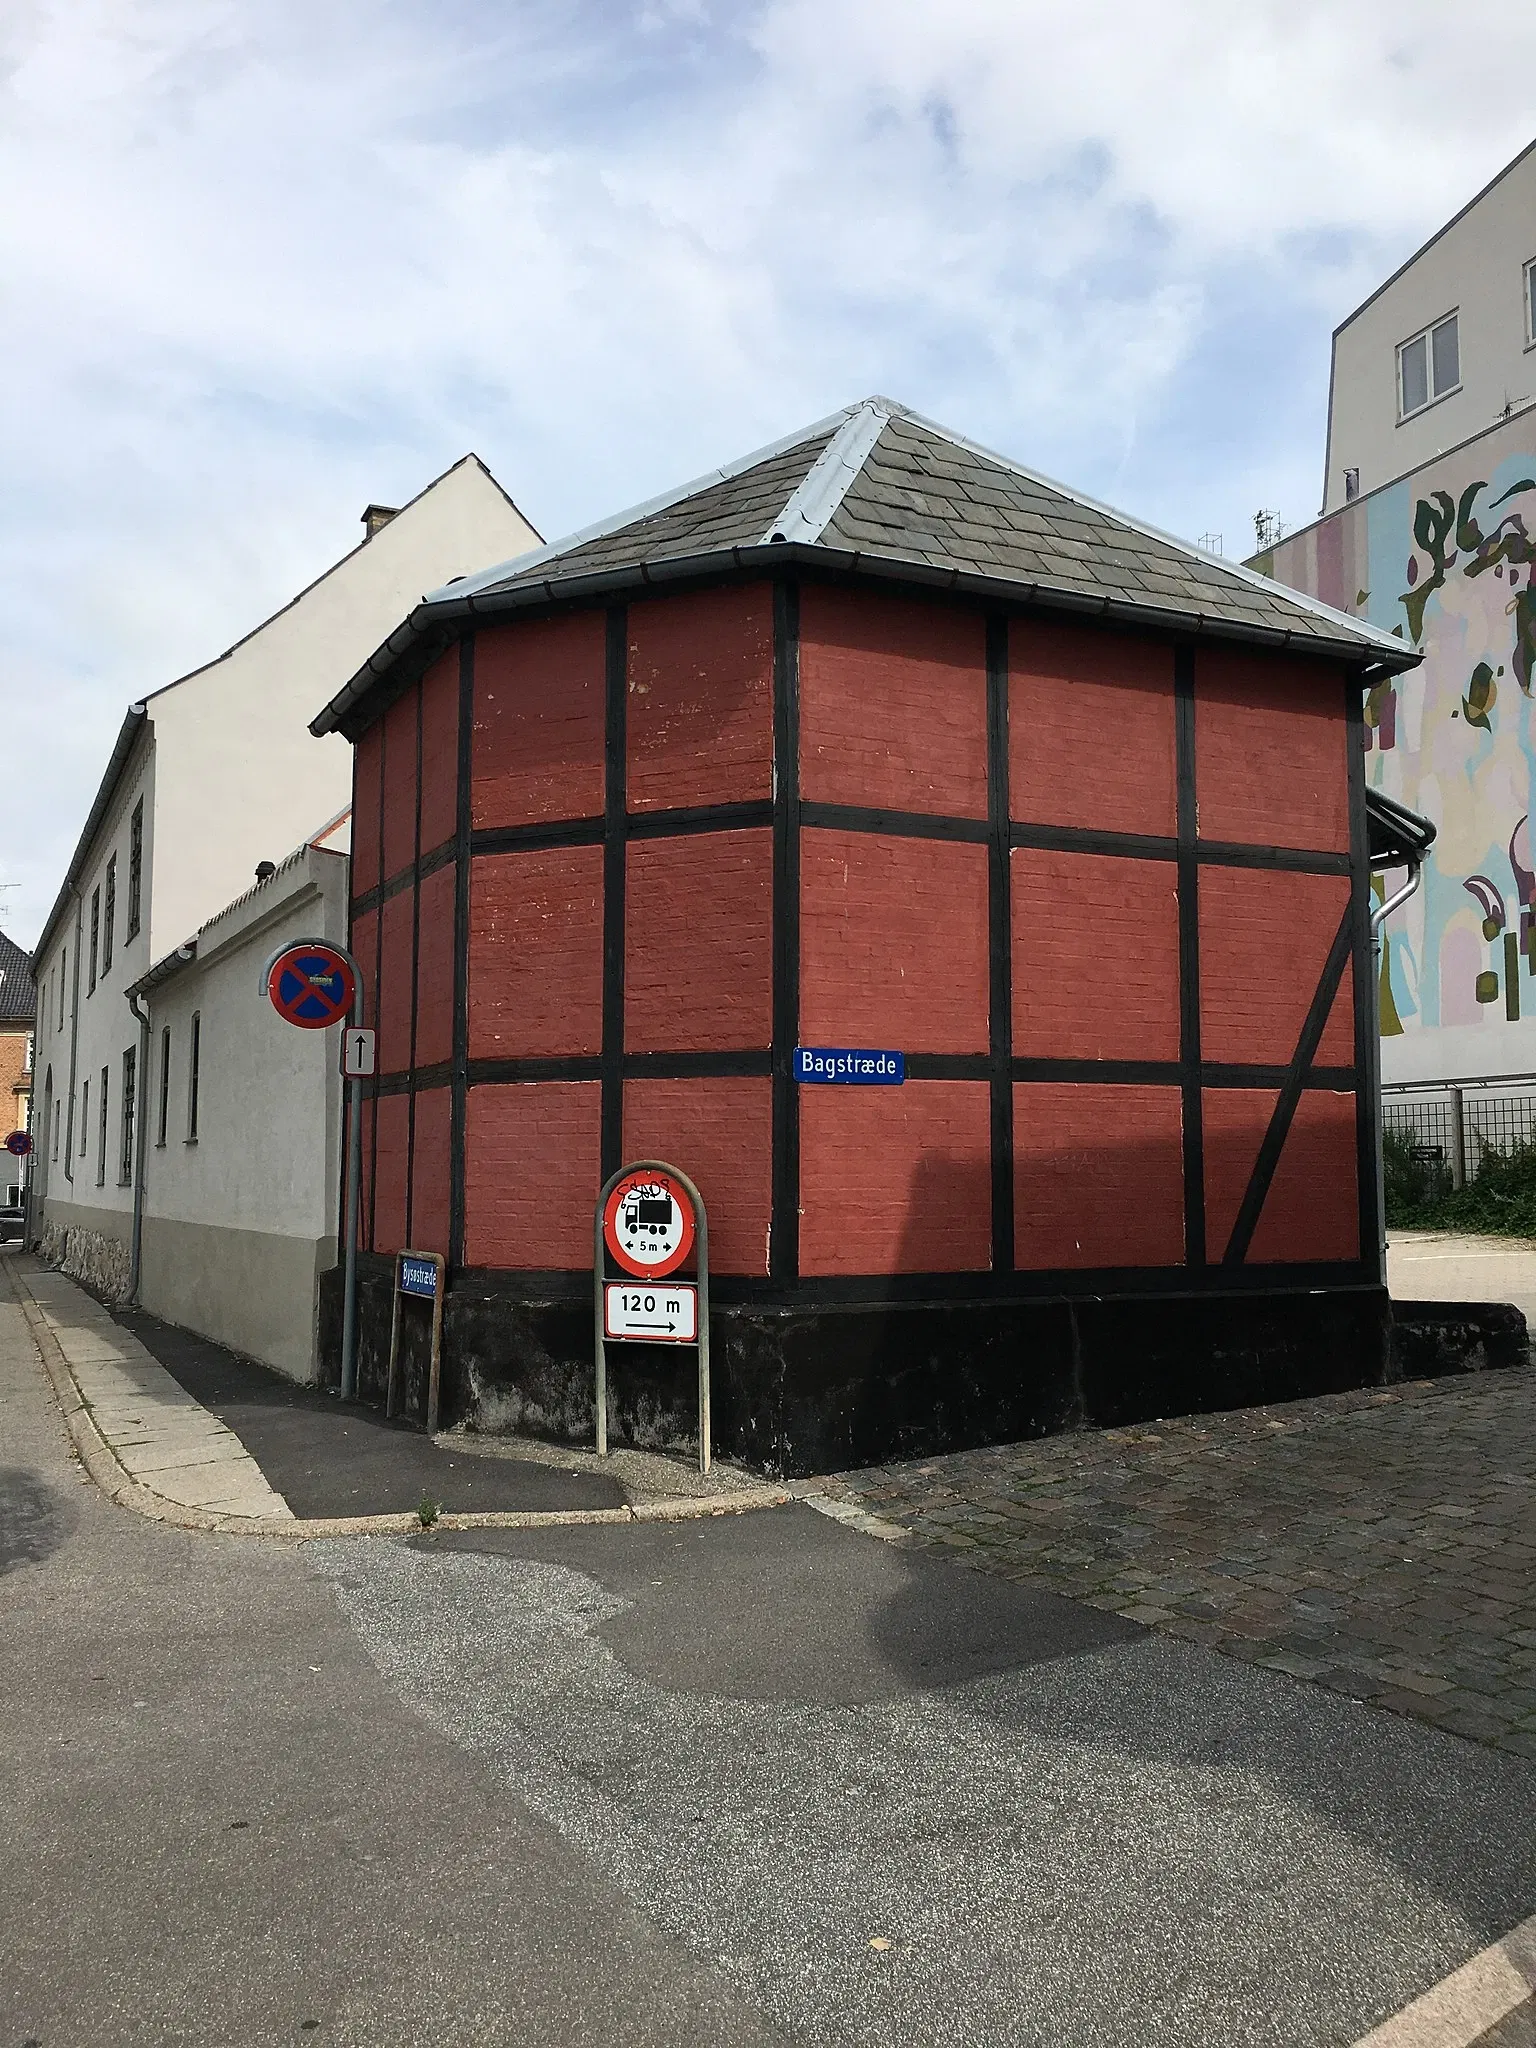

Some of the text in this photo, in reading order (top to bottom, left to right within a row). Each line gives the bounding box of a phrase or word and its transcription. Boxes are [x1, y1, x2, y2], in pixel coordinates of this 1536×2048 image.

[802, 1051, 896, 1078] Bagstræde
[403, 1262, 437, 1287] Bysøstræde
[621, 1294, 680, 1314] 120 m
